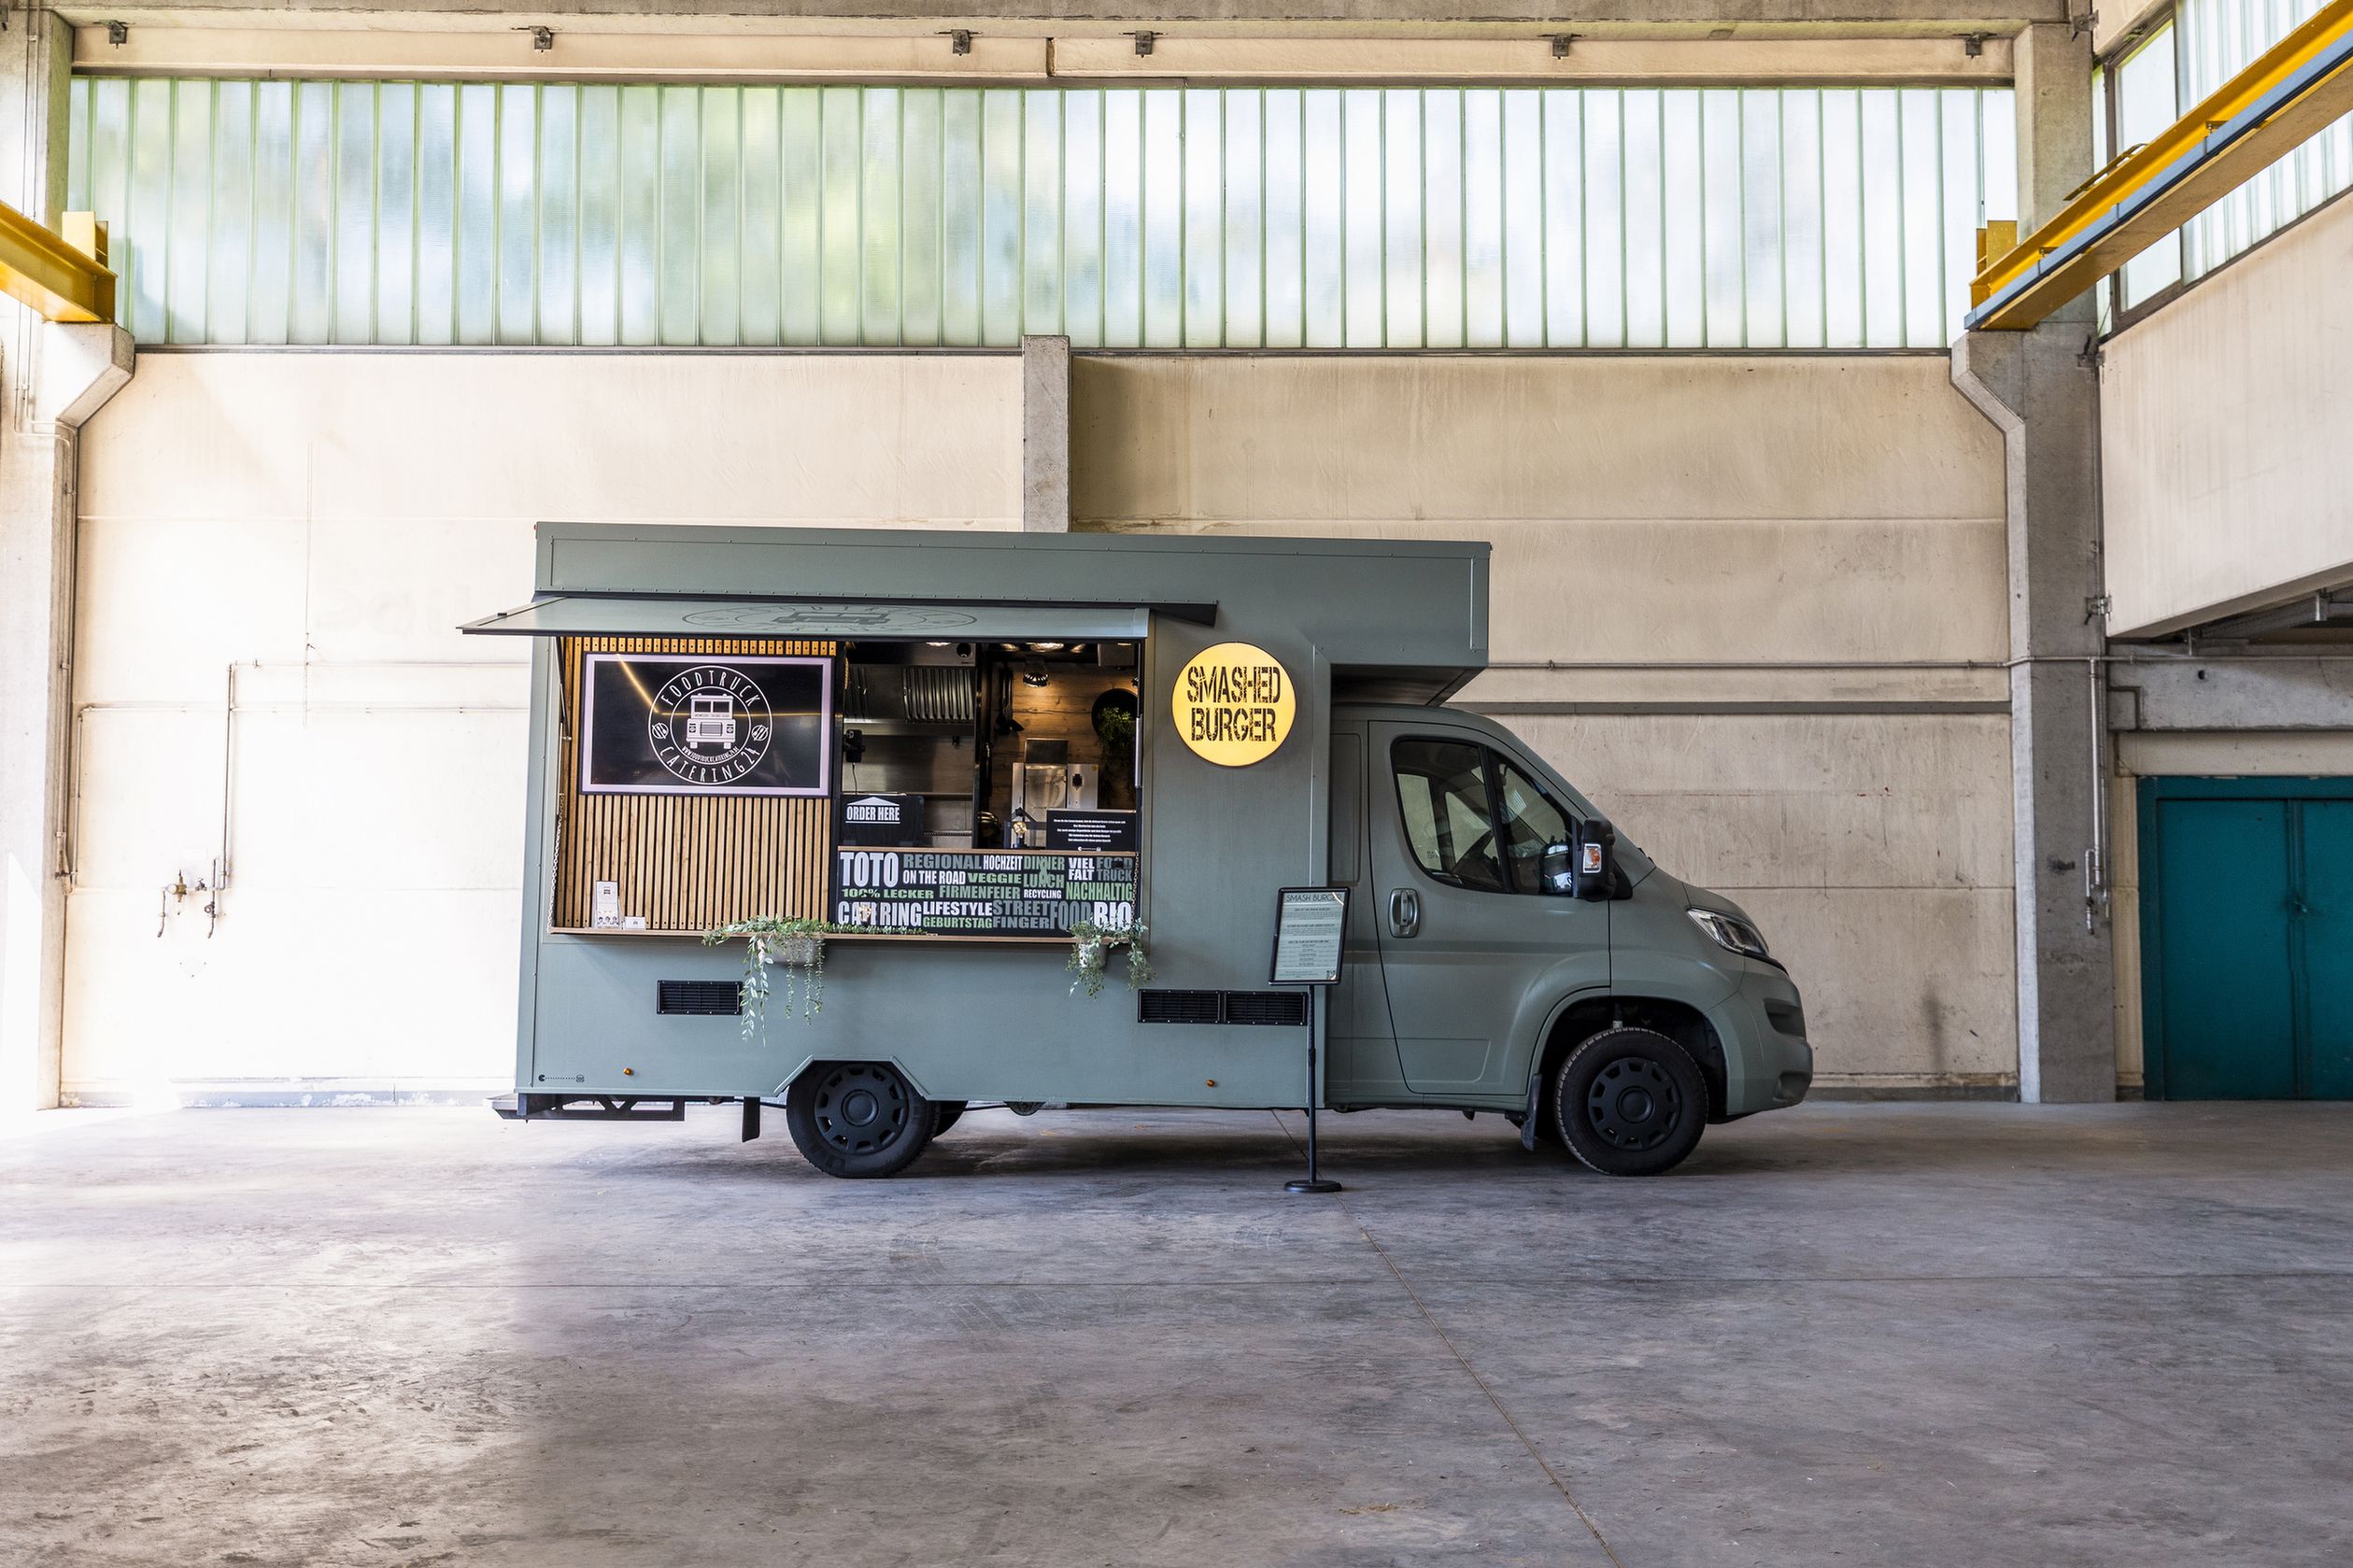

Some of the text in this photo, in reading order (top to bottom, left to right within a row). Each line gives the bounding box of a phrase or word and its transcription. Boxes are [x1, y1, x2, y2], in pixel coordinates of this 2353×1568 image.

[660, 670, 760, 707] FOODTRUCK
[1186, 666, 1281, 703] SMASHED
[1191, 707, 1277, 742] BURGER
[659, 746, 760, 783] CATERING24
[846, 806, 900, 821] ORDER HERE
[903, 854, 983, 869] REGIONAL
[983, 855, 1023, 870] HOCHZEIT
[1024, 855, 1065, 870] DINNER
[1068, 857, 1095, 869] VIEL
[840, 852, 899, 887] TOTO
[903, 869, 966, 885] ON THE ROAD
[1068, 869, 1095, 881] FALT
[1097, 869, 1133, 882] TRUCK
[967, 872, 1022, 883] VEGGIE
[842, 888, 934, 899] 100% LECKER
[939, 885, 1020, 899] FIRMENFEIER
[1023, 888, 1062, 899] RECYCLING
[1066, 882, 1133, 901] NACHHALTIG
[1286, 894, 1311, 902] SMASH
[923, 901, 992, 916] LIFESTYLE
[992, 900, 1050, 916] STREET
[922, 916, 993, 928] GEBURTSTAG
[992, 916, 1050, 929] FINGER
[1050, 901, 1092, 931] FOOD
[1093, 901, 1132, 932] BIO
